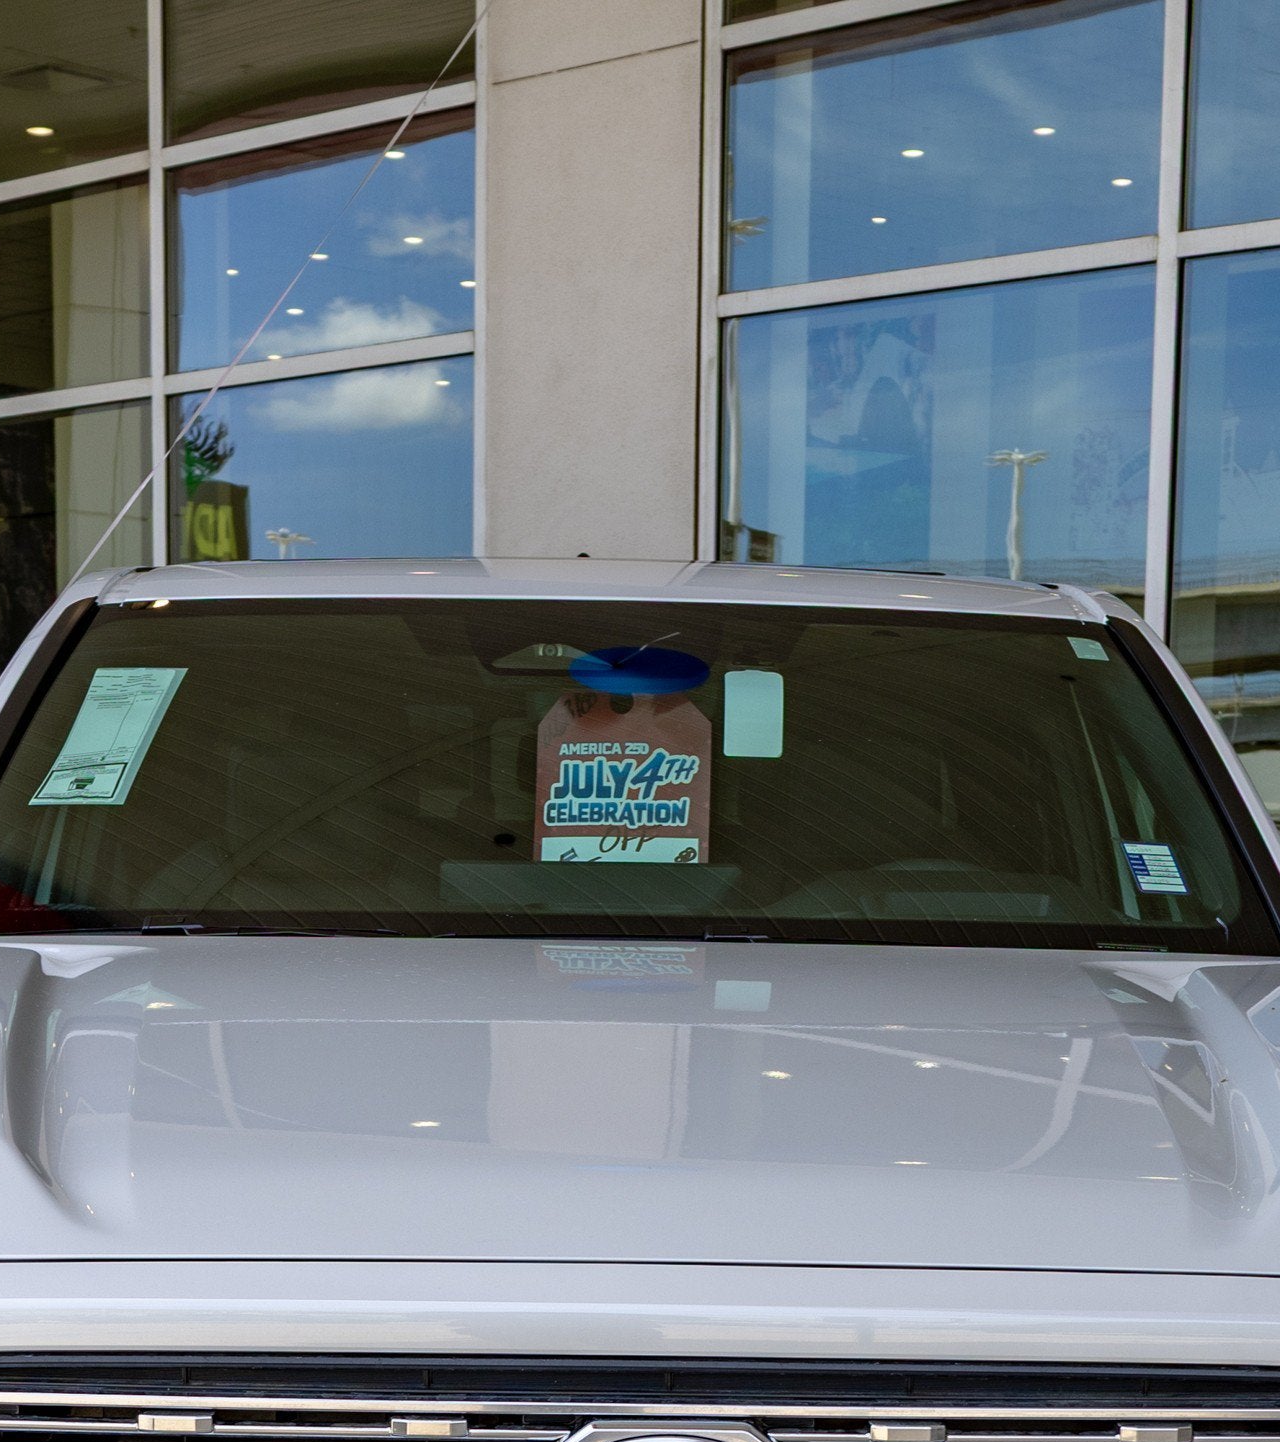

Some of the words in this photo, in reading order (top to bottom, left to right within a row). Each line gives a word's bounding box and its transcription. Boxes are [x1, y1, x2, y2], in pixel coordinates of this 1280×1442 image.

[559, 742, 622, 755] AMERICA
[553, 757, 636, 800] JULY
[631, 751, 697, 801] 4TH
[545, 799, 688, 826] CELEBRATION
